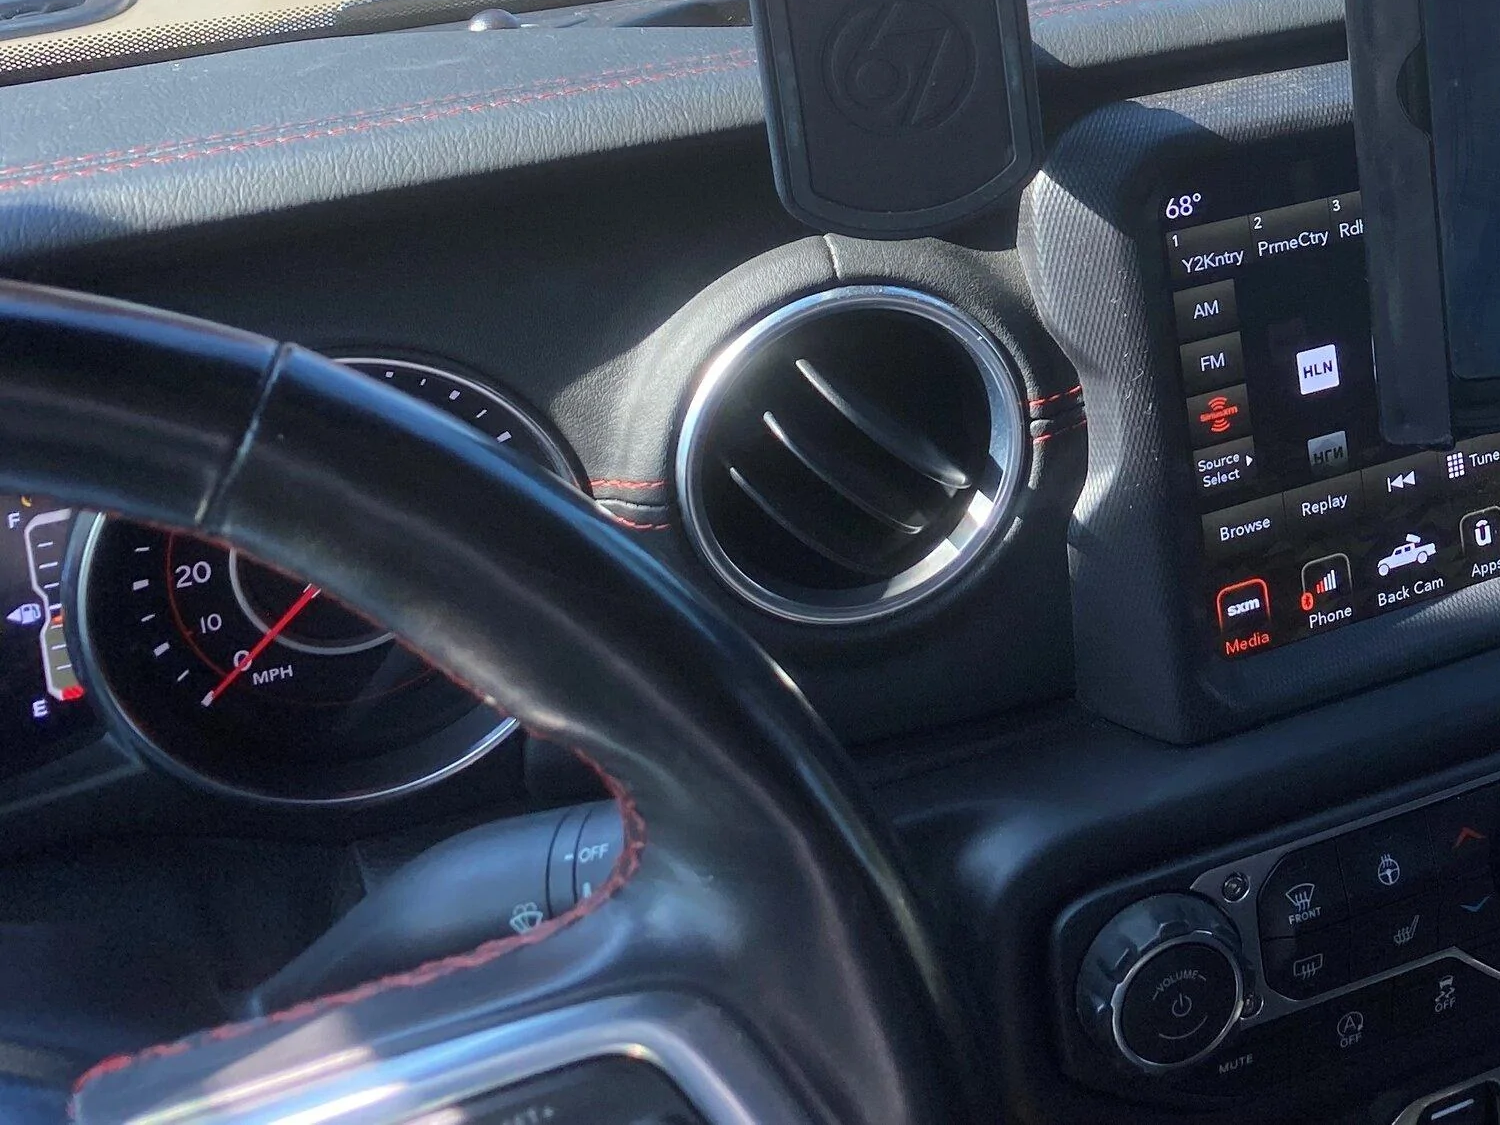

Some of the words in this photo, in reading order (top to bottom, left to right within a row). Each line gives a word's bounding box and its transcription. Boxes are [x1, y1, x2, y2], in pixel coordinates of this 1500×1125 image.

[1332, 199, 1341, 212] 3
[1253, 217, 1263, 230] 2
[1172, 235, 1179, 247] 1
[1257, 230, 1329, 257] PrmeCtry
[1182, 250, 1245, 273] Y2Kntry
[1193, 300, 1220, 320] AM
[1200, 353, 1225, 372] FM
[1303, 360, 1334, 379] HLN
[1198, 452, 1241, 473] Source
[1469, 450, 1500, 468] Tune
[1202, 468, 1241, 488] Select
[1301, 494, 1348, 517] Replay
[8, 512, 20, 529] F
[1219, 518, 1271, 542] Browse
[174, 561, 212, 589] 20
[1378, 588, 1410, 607] Back
[1414, 577, 1444, 595] Cam
[1227, 598, 1261, 617] sxm
[1309, 606, 1353, 629] Phone
[199, 613, 222, 634] 10
[1225, 632, 1271, 655] Media
[252, 665, 294, 686] MPH
[32, 699, 48, 718] E
[579, 843, 609, 863] OFF
[1288, 906, 1322, 926] FRONT
[1156, 969, 1198, 994] VOLUME
[1434, 998, 1456, 1013] OFF
[1340, 1034, 1361, 1048] OFF
[1218, 1053, 1253, 1074] MUTE
